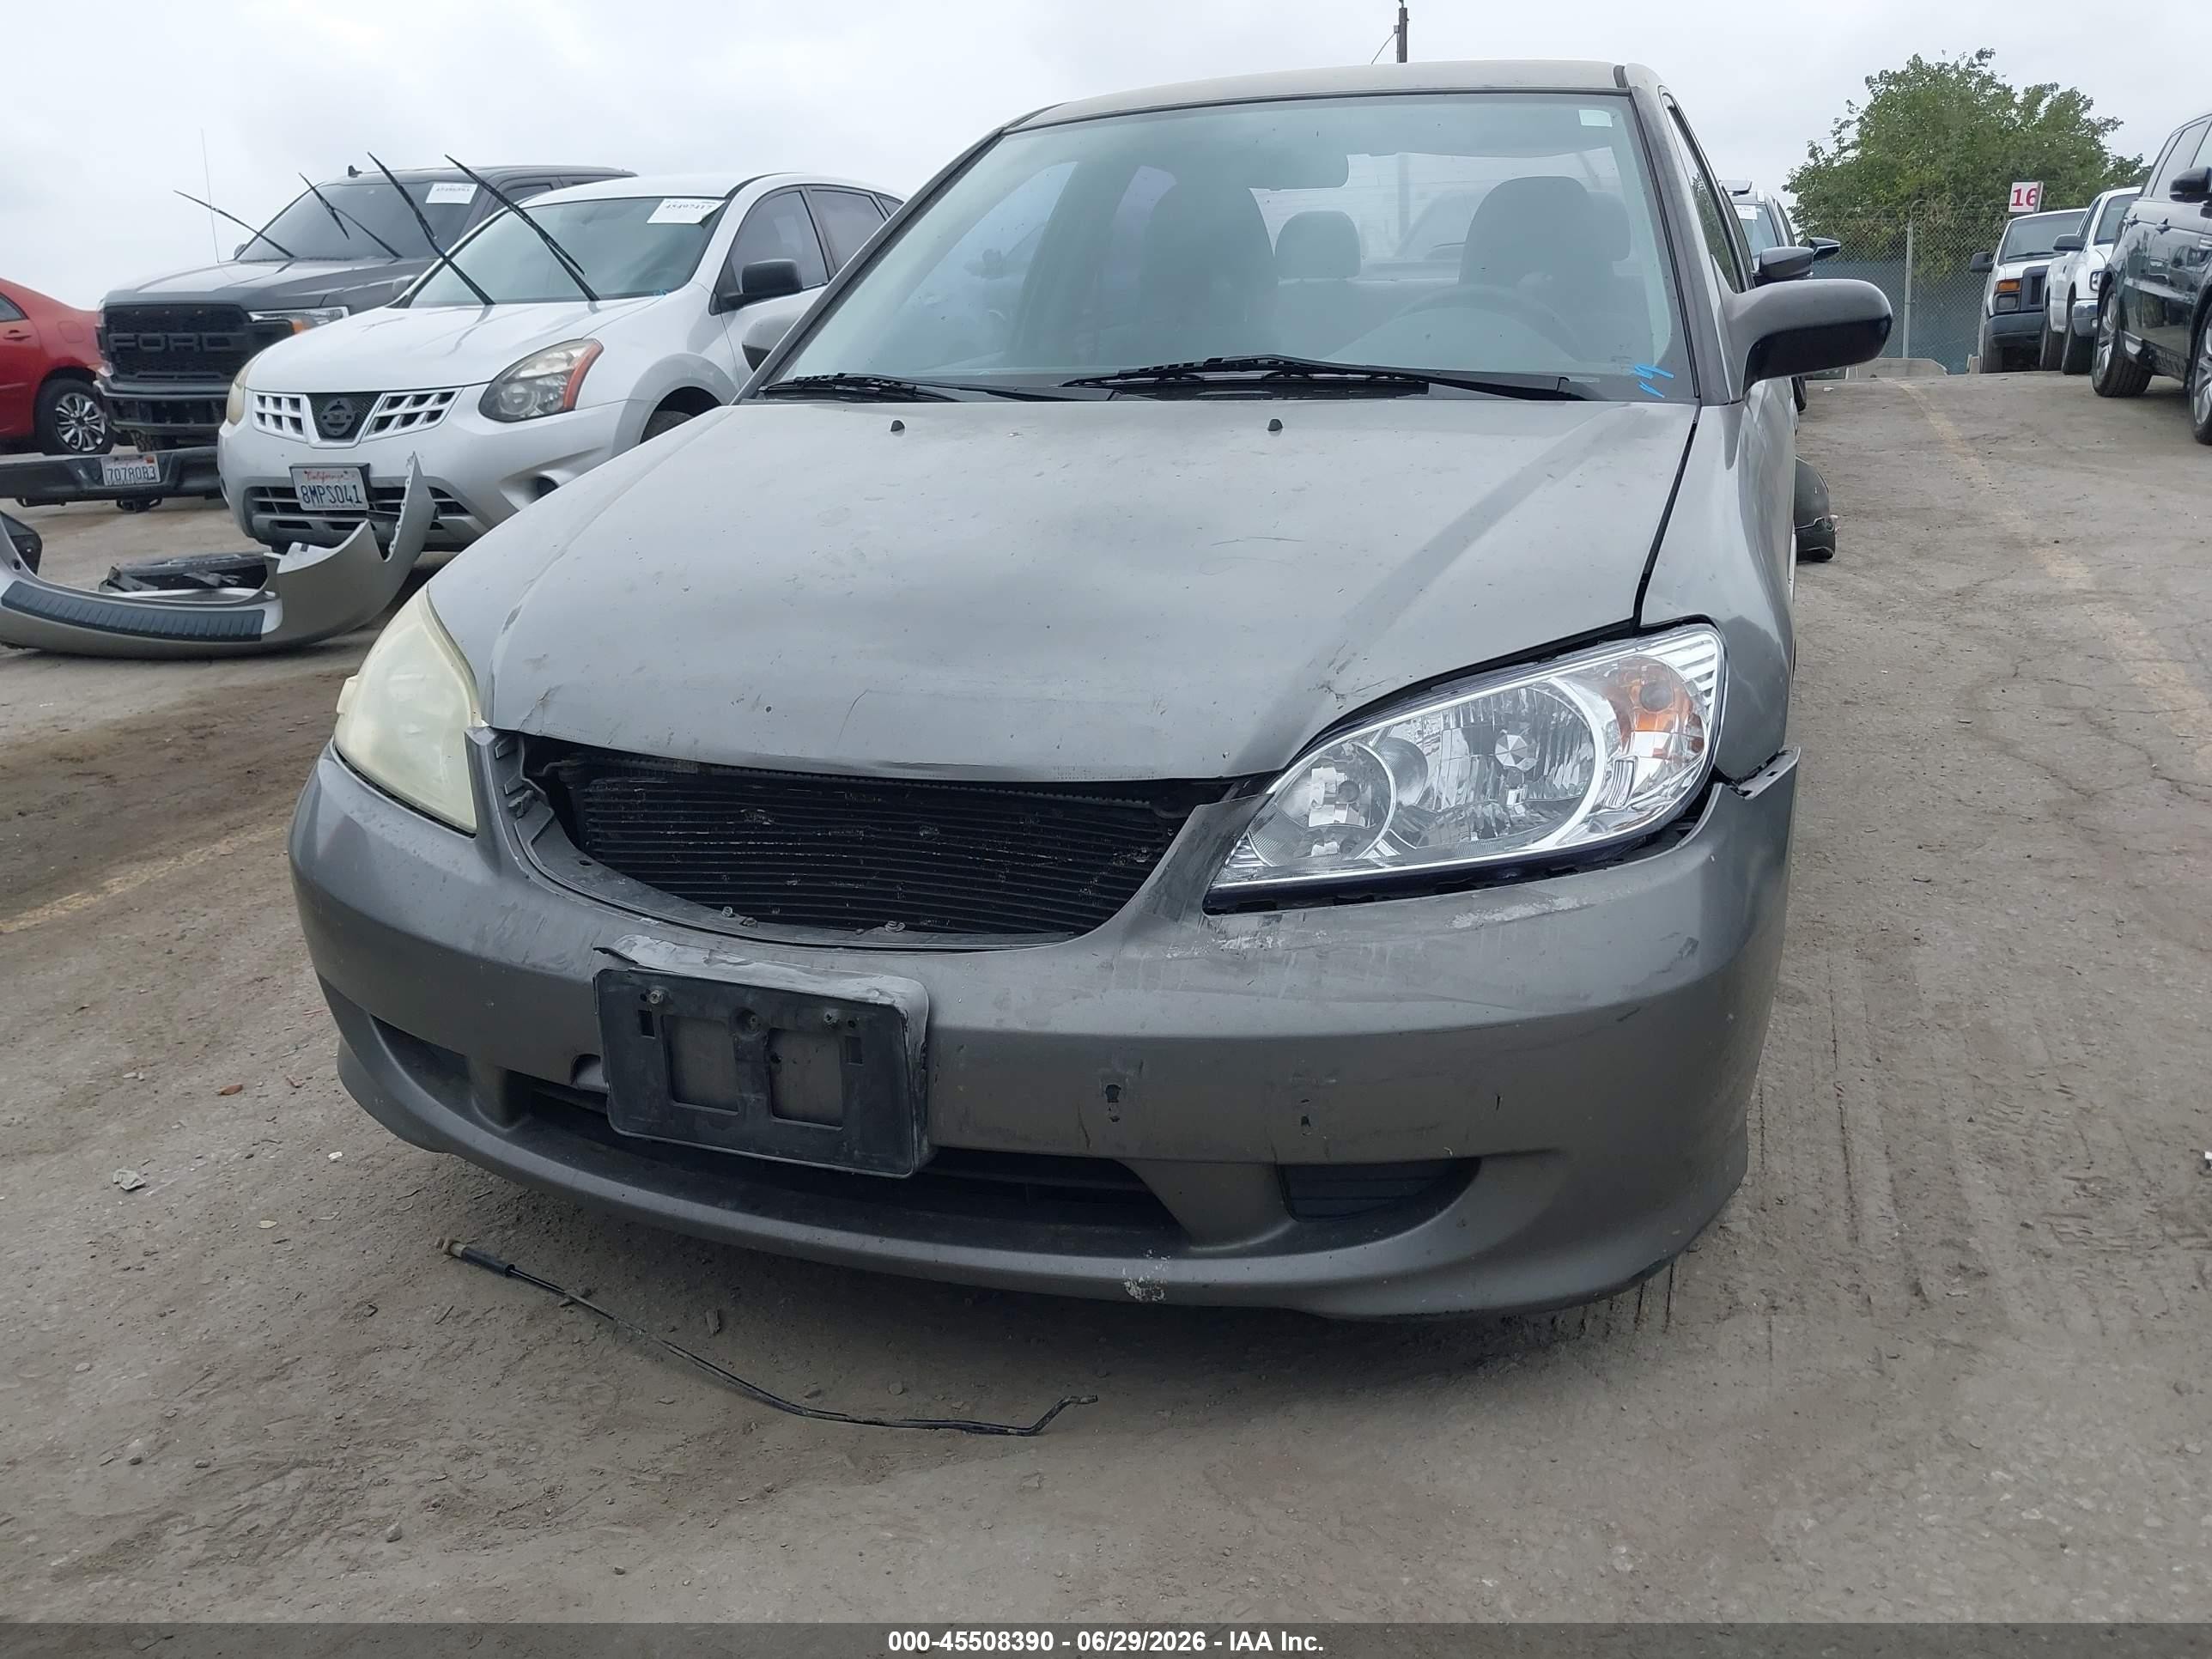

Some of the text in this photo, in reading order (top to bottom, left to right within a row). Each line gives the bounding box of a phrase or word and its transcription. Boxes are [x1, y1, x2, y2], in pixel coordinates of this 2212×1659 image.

[2011, 187, 2037, 206] 16
[108, 332, 235, 352] FORD
[301, 484, 362, 504] 8MPS041
